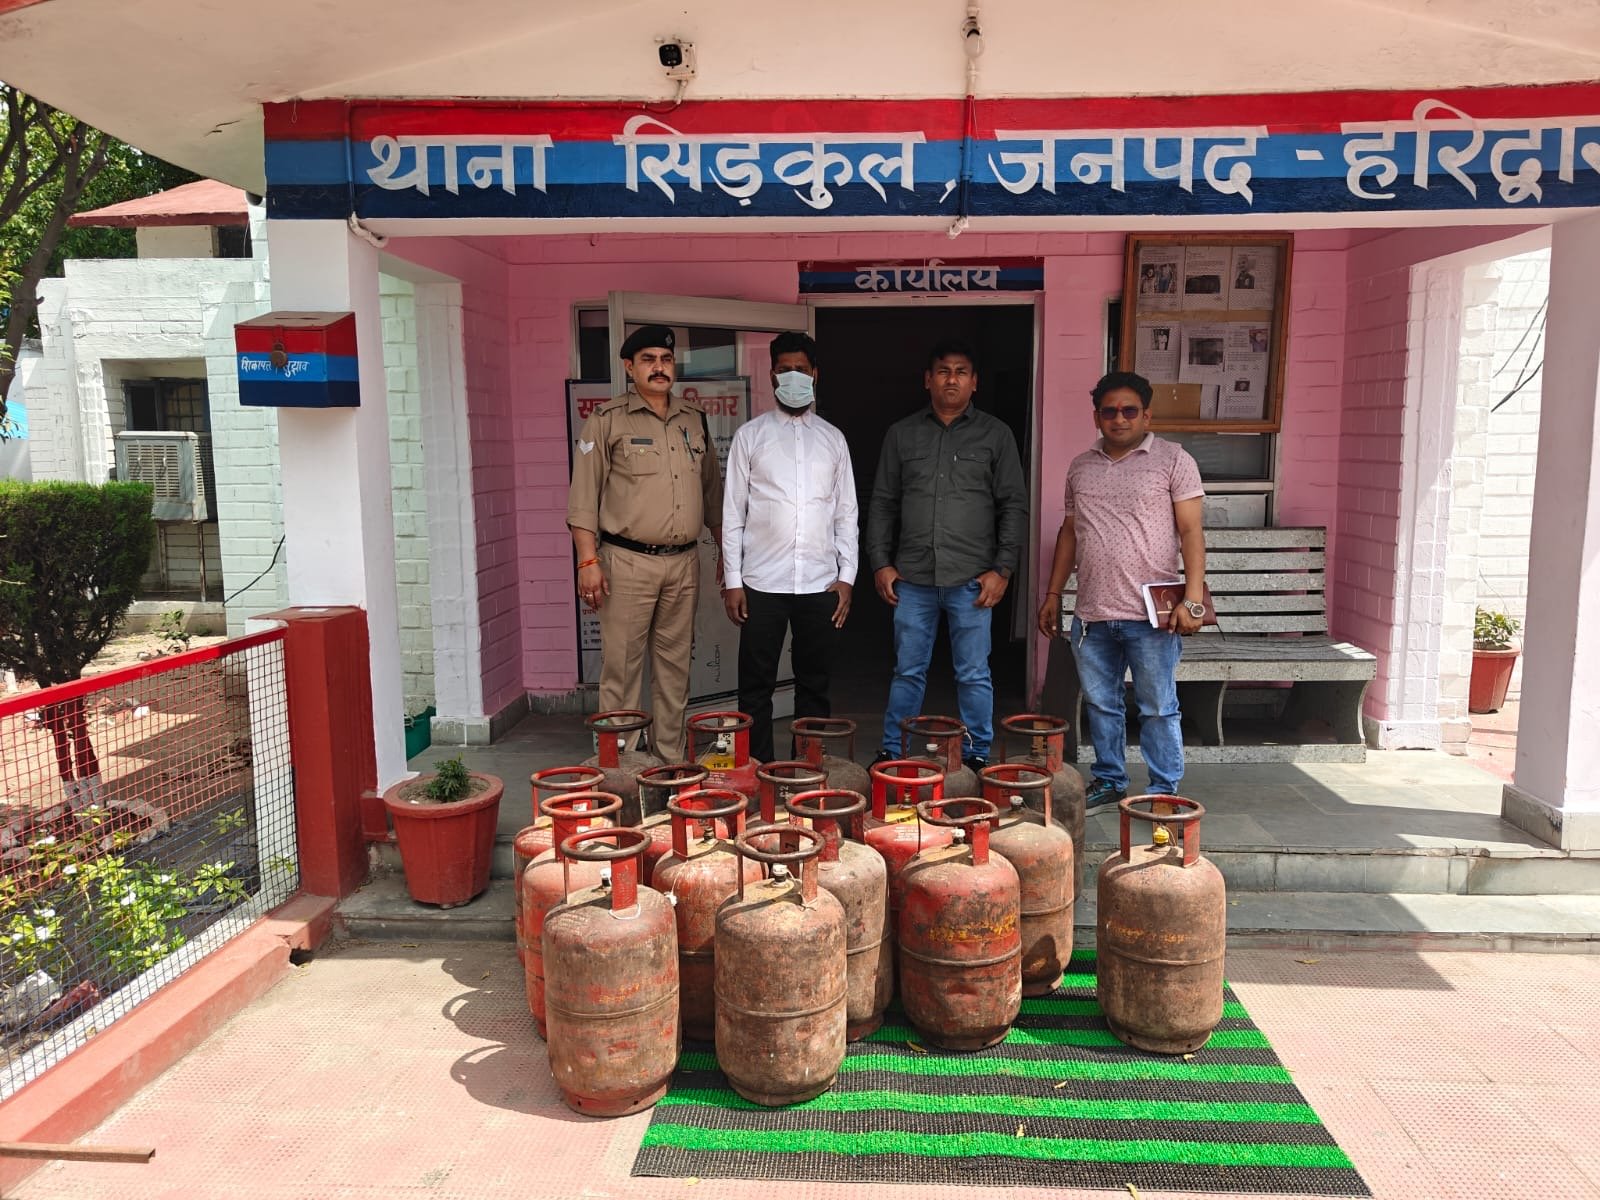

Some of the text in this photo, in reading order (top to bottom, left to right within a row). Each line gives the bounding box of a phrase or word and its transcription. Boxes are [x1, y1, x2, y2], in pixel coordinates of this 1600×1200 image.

[366, 134, 554, 197] थाना
[988, 125, 1269, 207] जनपद
[854, 257, 1001, 292] कार्यालय
